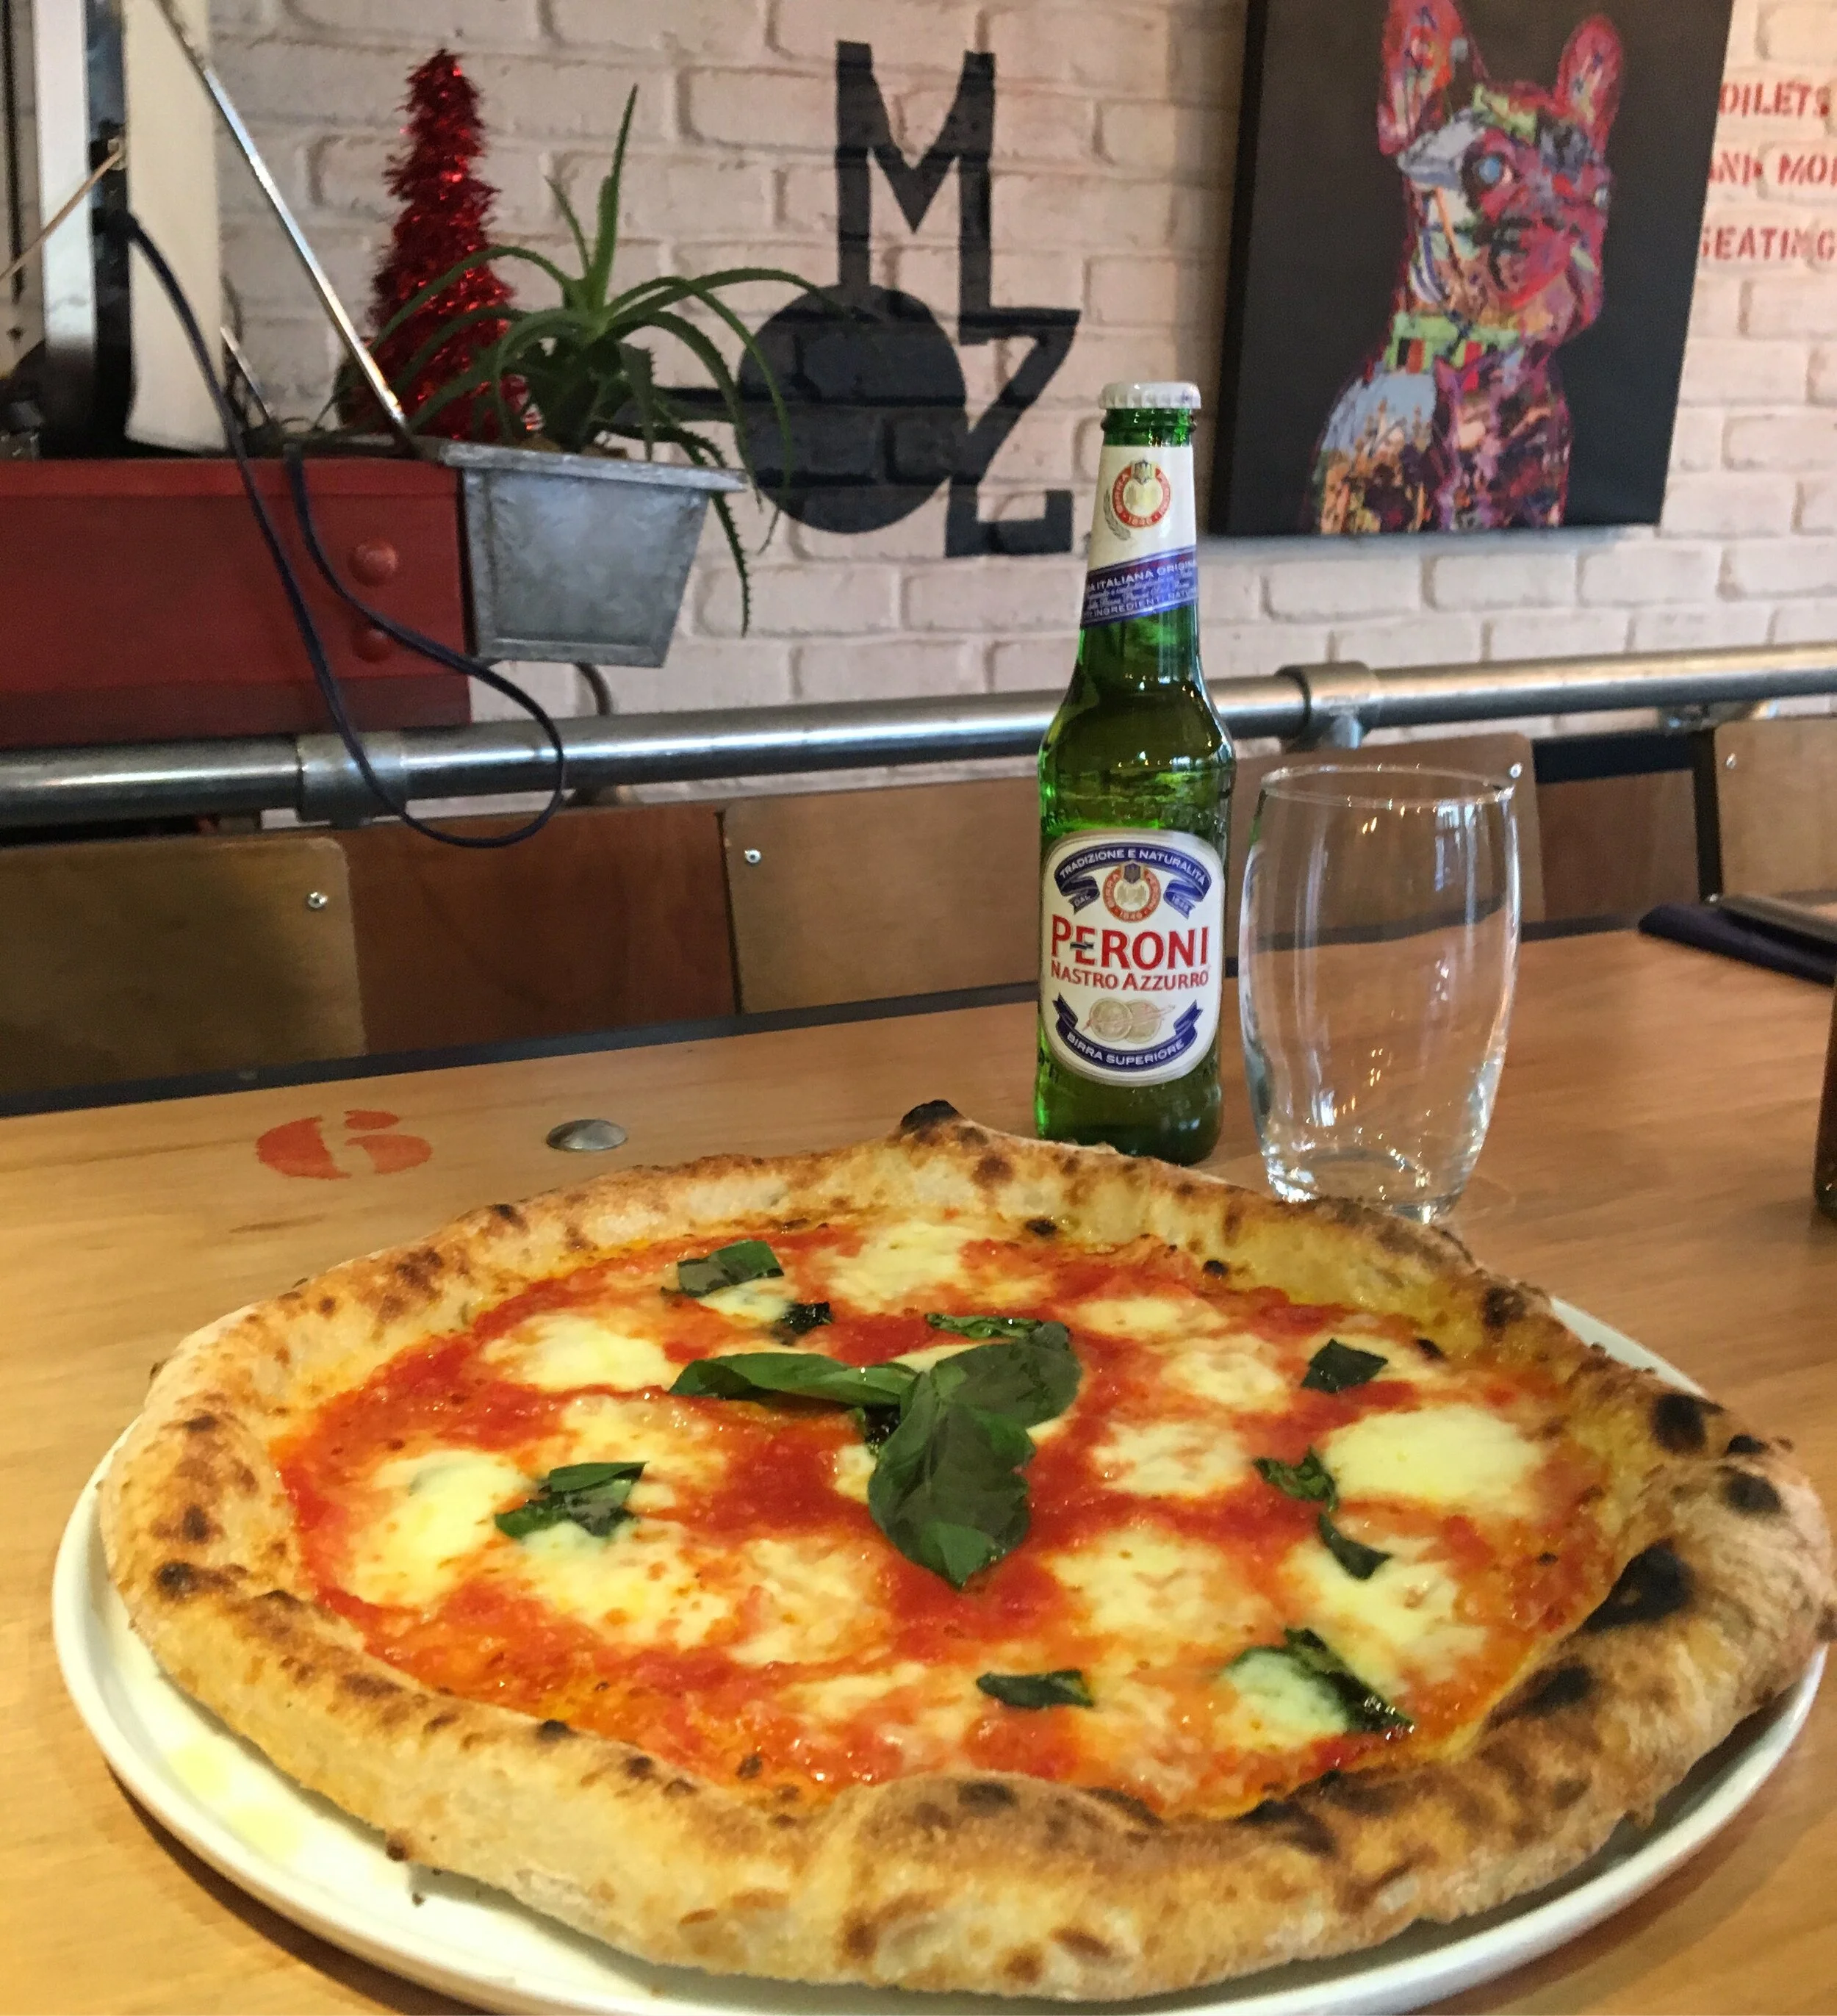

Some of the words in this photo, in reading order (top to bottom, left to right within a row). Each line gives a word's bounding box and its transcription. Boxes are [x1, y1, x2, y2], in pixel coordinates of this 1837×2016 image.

[1096, 569, 1154, 590] ITALIANA
[1060, 848, 1125, 878] TRADIZIONE
[1127, 848, 1137, 859] E
[1051, 914, 1209, 971] PERONI
[1050, 960, 1118, 990] NASTRO
[1121, 969, 1209, 991] AZZURRO
[1067, 1031, 1103, 1062] BIRRA
[1105, 1040, 1184, 1066] SUPERIORE
